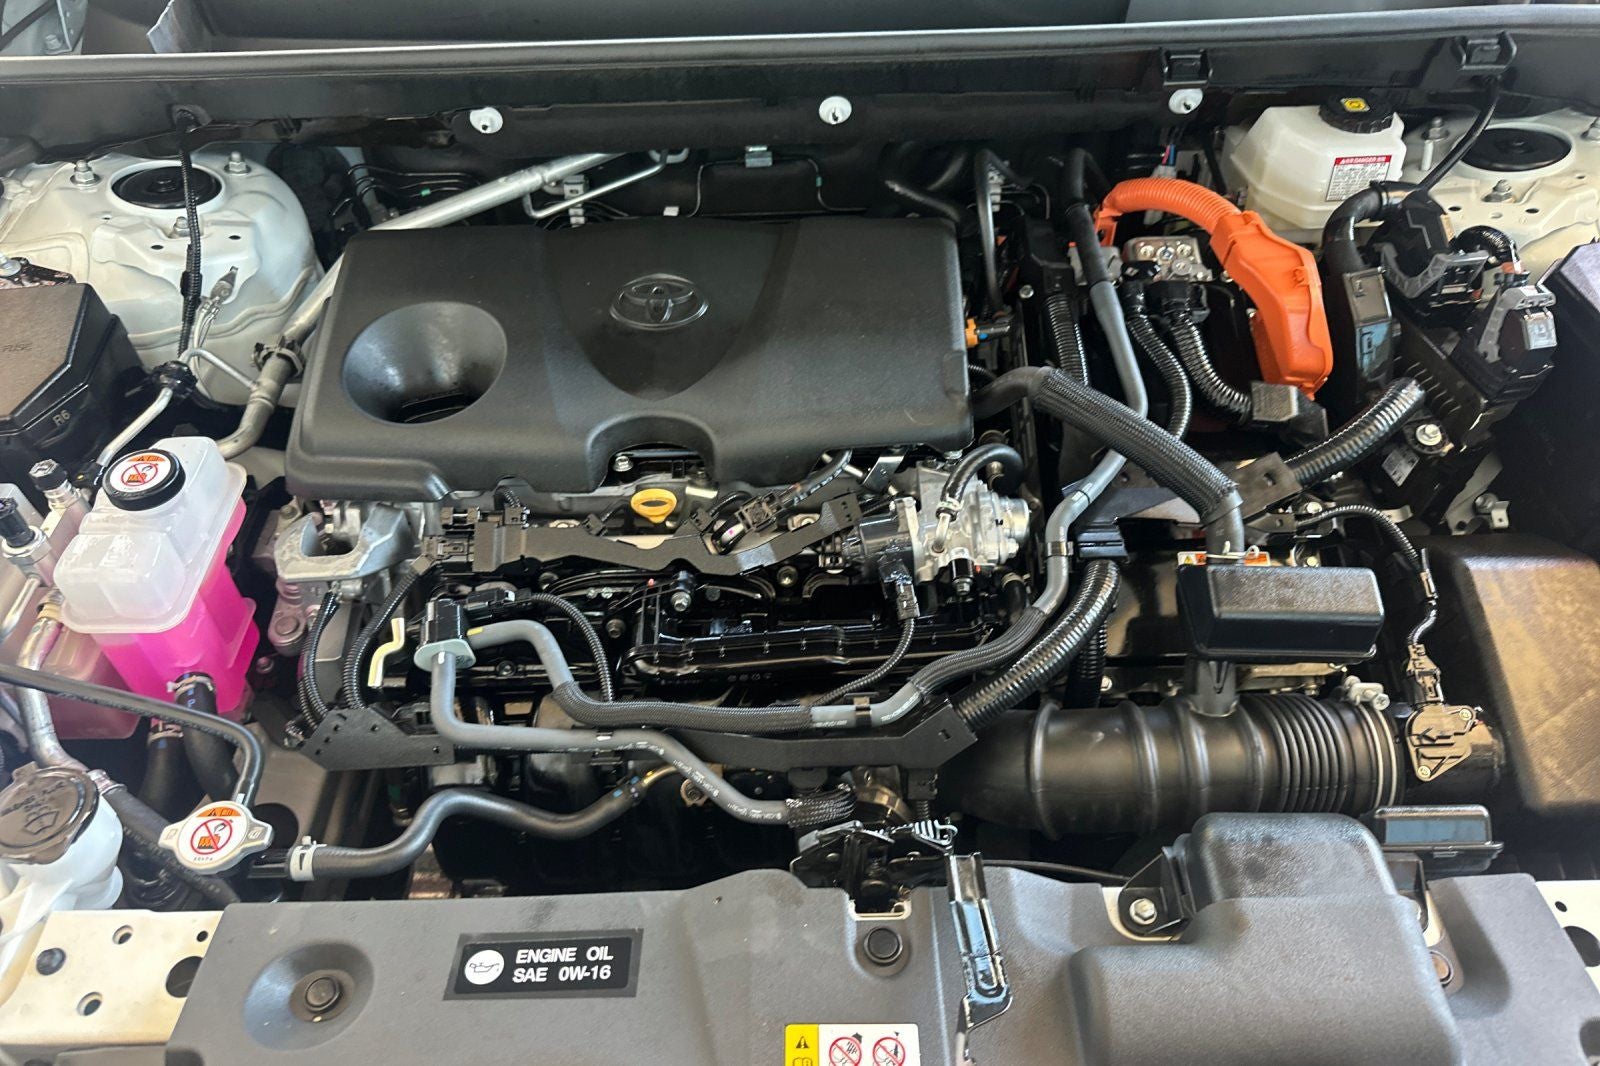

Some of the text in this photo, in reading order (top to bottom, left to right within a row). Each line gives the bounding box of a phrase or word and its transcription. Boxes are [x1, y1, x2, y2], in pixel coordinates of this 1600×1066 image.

[53, 410, 70, 426] R6
[515, 945, 614, 964] ENGINE OIL
[512, 965, 612, 983] SAE 0W-16
